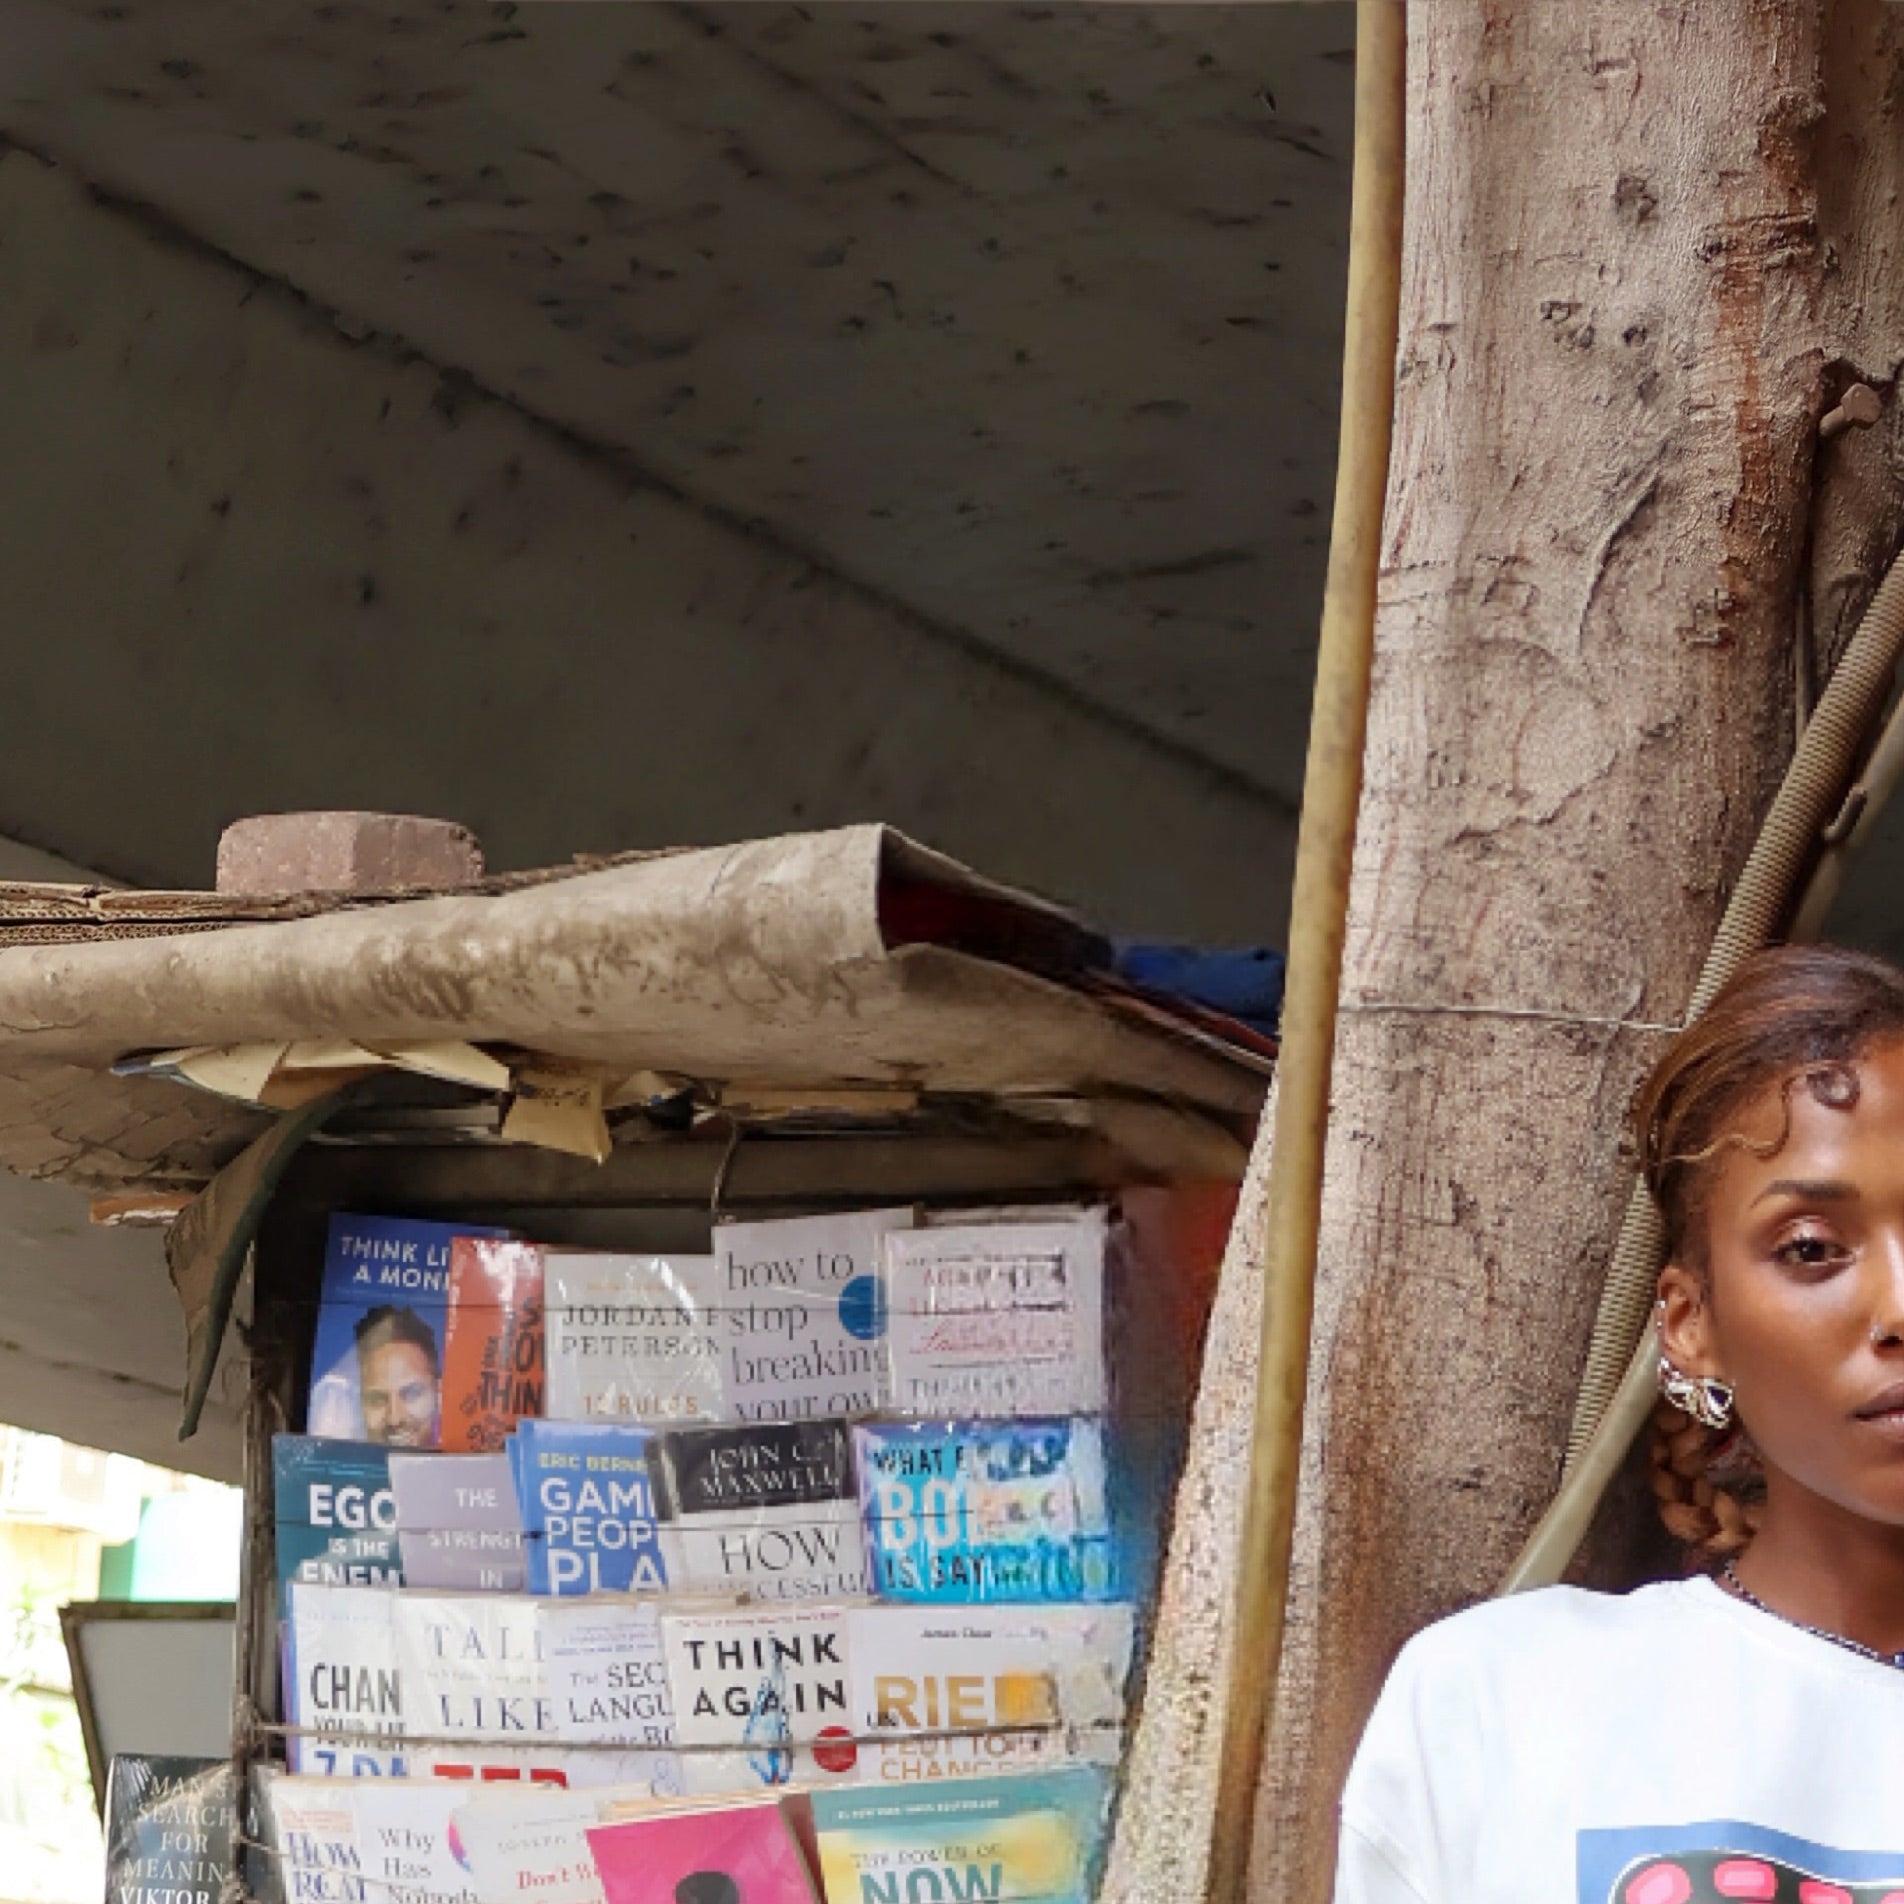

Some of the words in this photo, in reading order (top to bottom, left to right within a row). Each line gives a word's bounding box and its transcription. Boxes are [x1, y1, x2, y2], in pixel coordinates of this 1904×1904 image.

[341, 1235, 417, 1264] THINK
[353, 1266, 371, 1285] A
[728, 1250, 805, 1291] how
[816, 1247, 854, 1281] to
[562, 1304, 694, 1328] JORDAN
[728, 1303, 809, 1341] stop
[561, 1335, 720, 1358] PETERSON
[732, 1340, 889, 1387] breaking
[539, 1452, 580, 1470] ERIC
[709, 1446, 780, 1470] JOHN
[873, 1446, 944, 1475] WHAT
[700, 1466, 844, 1497] MAXWELL
[308, 1483, 398, 1529] EGO
[454, 1487, 498, 1509] THE
[427, 1529, 522, 1551] STRENGT
[546, 1516, 652, 1550] PEOP
[328, 1538, 347, 1555] IS
[351, 1539, 389, 1561] THE
[719, 1526, 841, 1574] HOW
[479, 1569, 504, 1589] IN
[886, 1557, 913, 1589] IS
[921, 1627, 956, 1640] James
[682, 1632, 843, 1671] THINK
[311, 1662, 400, 1715] CHAN
[692, 1679, 847, 1717] AGAIN
[440, 1693, 558, 1732] LIKE
[569, 1694, 675, 1724] LANGU
[136, 1802, 238, 1825] SEARCH
[160, 1833, 209, 1854] FOR
[378, 1827, 433, 1854] Why
[898, 1844, 974, 1866] POWER
[977, 1843, 1001, 1858] OF
[384, 1858, 432, 1879] Has
[517, 1868, 571, 1890] Don't
